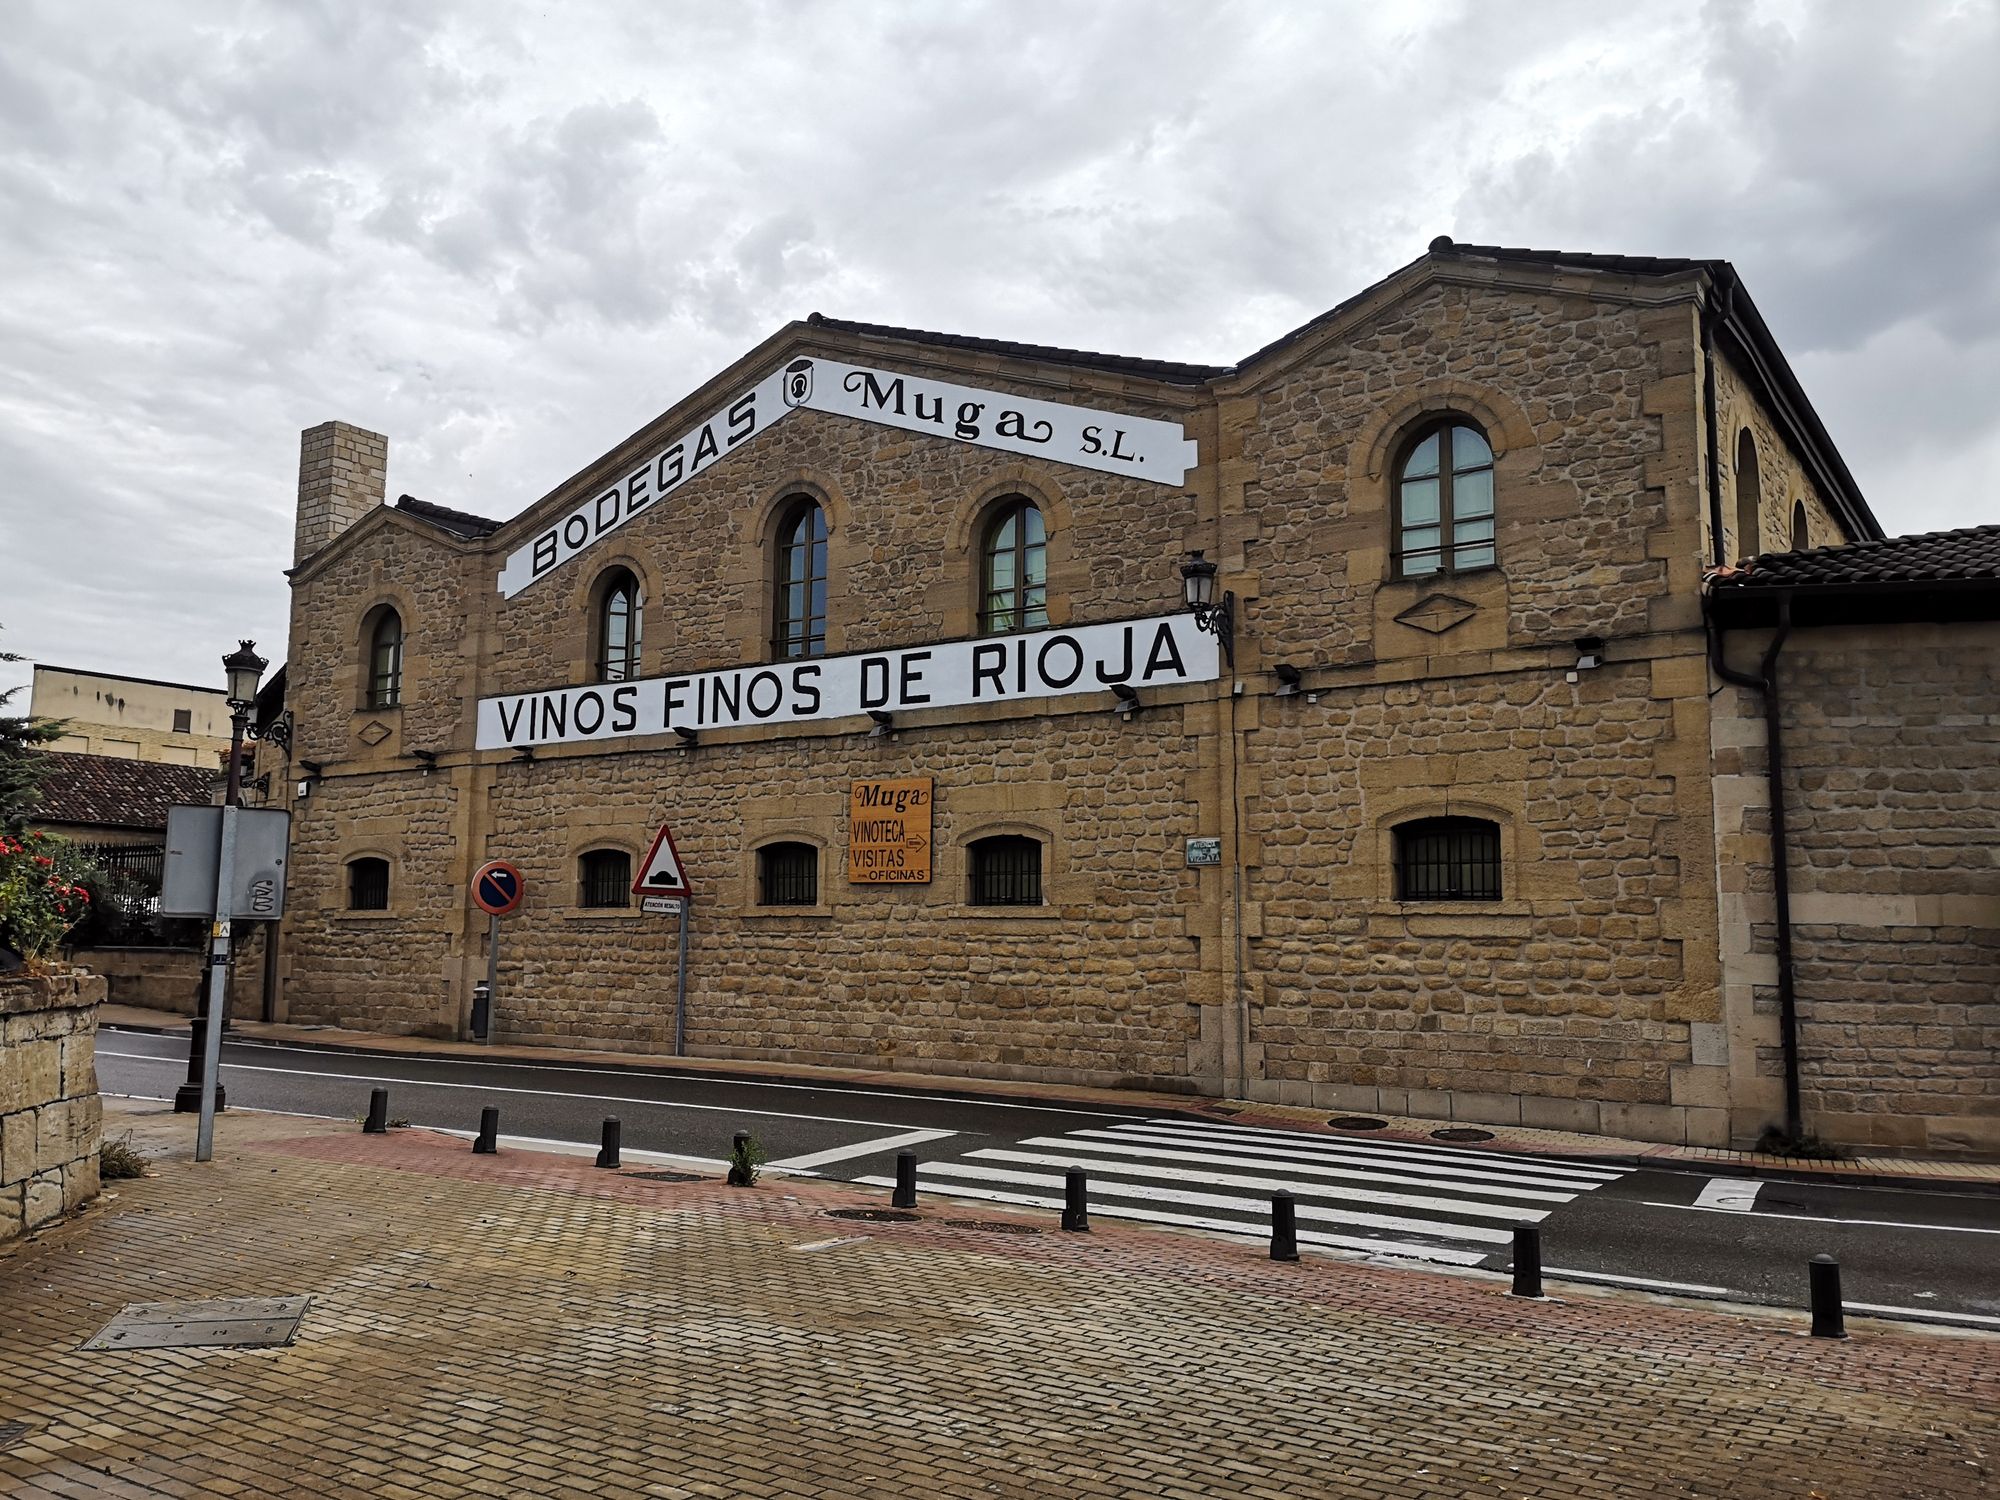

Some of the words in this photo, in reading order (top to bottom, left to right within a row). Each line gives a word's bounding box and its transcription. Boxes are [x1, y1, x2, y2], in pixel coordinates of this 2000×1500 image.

[532, 392, 756, 578] BODEGAS
[843, 371, 1053, 443] Muga
[1079, 425, 1145, 463] S.L.
[498, 686, 637, 742] VINOS
[663, 665, 821, 728] FINOS
[860, 651, 931, 708] DE
[972, 622, 1186, 697] RIOJA
[854, 785, 929, 813] Muga
[853, 820, 905, 843] VINOTECA
[853, 849, 905, 868] VISITAS
[869, 870, 925, 881] OFICINAS
